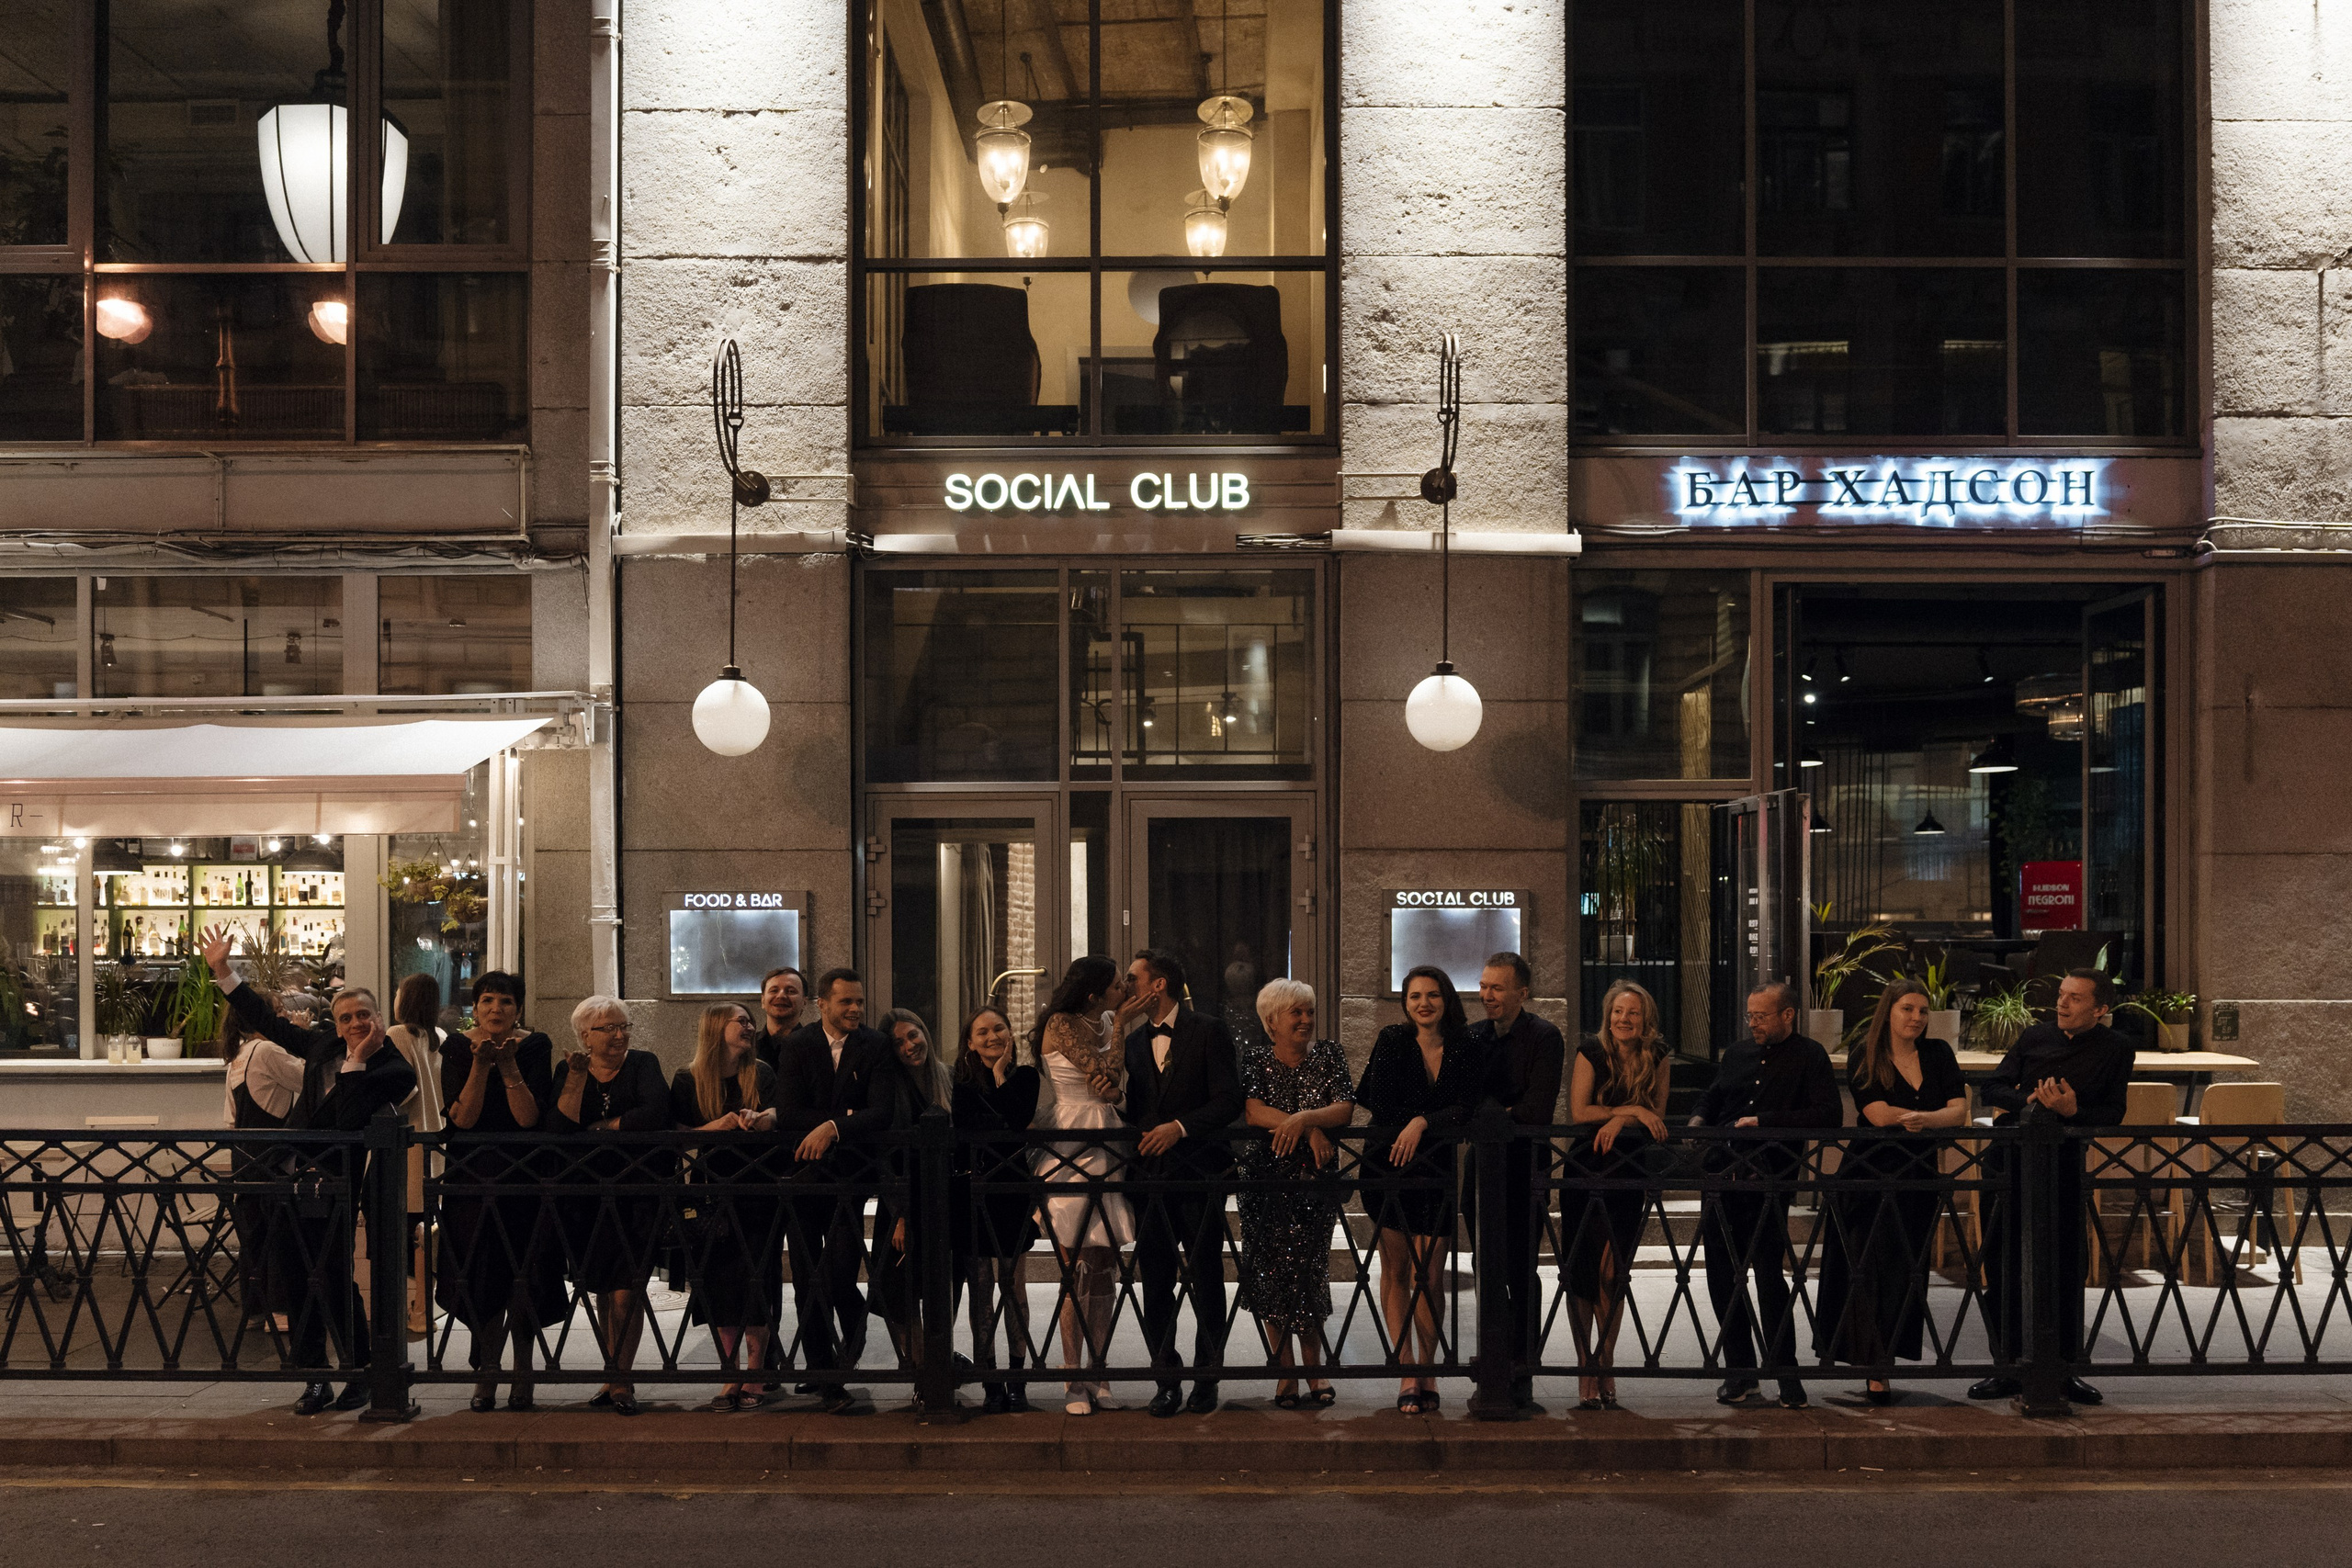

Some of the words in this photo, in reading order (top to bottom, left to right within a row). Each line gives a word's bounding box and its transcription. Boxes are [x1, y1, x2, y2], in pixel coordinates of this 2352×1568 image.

[944, 471, 1111, 512] SOCIAL
[1129, 471, 1250, 512] CLUB
[1684, 470, 1801, 509] БАР
[1827, 468, 2096, 517] ХАДСОН
[2032, 883, 2070, 892] HUDSON
[684, 893, 732, 908] FOOD
[735, 893, 748, 908] &
[750, 893, 783, 908] BAR
[1396, 891, 1466, 906] SOCIAL
[1469, 891, 1515, 906] CLUB
[2028, 895, 2075, 906] NEGRONI
